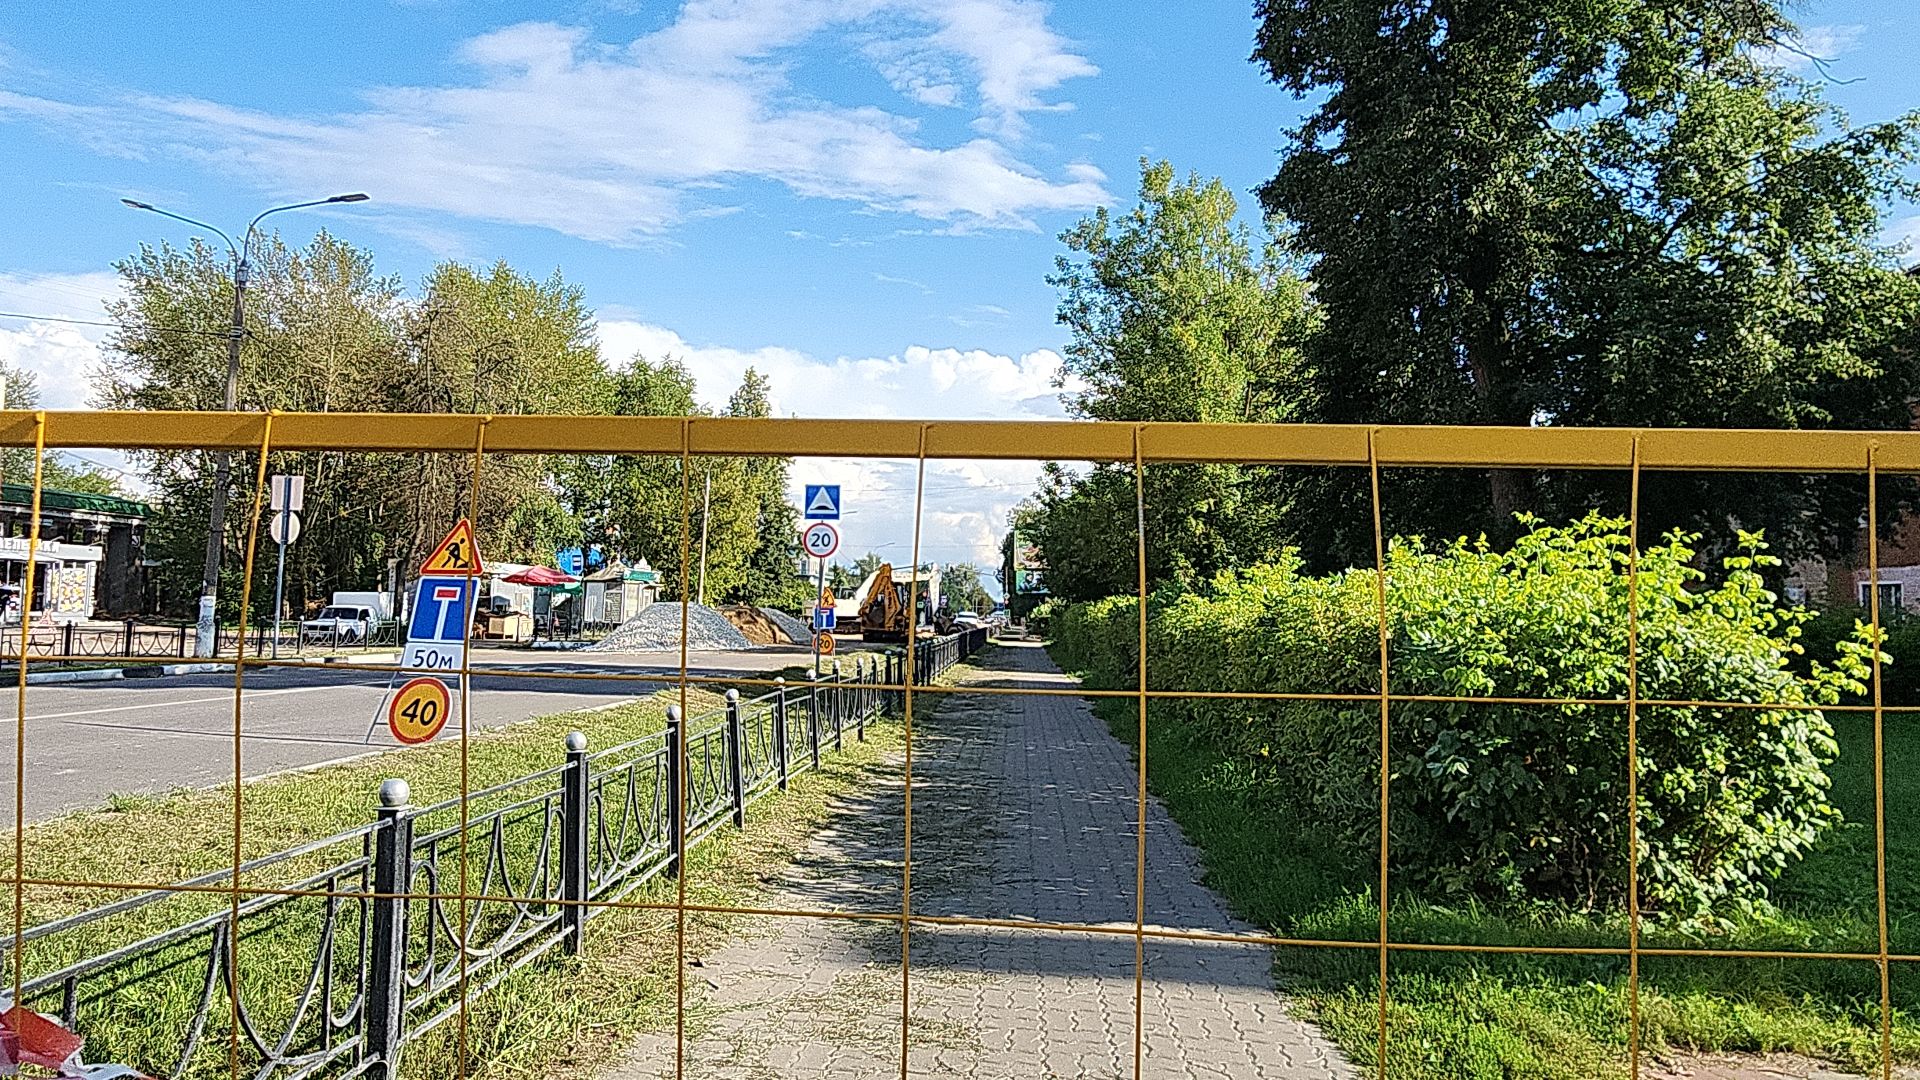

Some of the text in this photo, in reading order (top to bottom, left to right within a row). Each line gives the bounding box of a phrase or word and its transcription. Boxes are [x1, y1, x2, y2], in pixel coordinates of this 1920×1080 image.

[811, 532, 831, 547] 20
[818, 639, 831, 649] 20
[401, 698, 437, 726] 40
